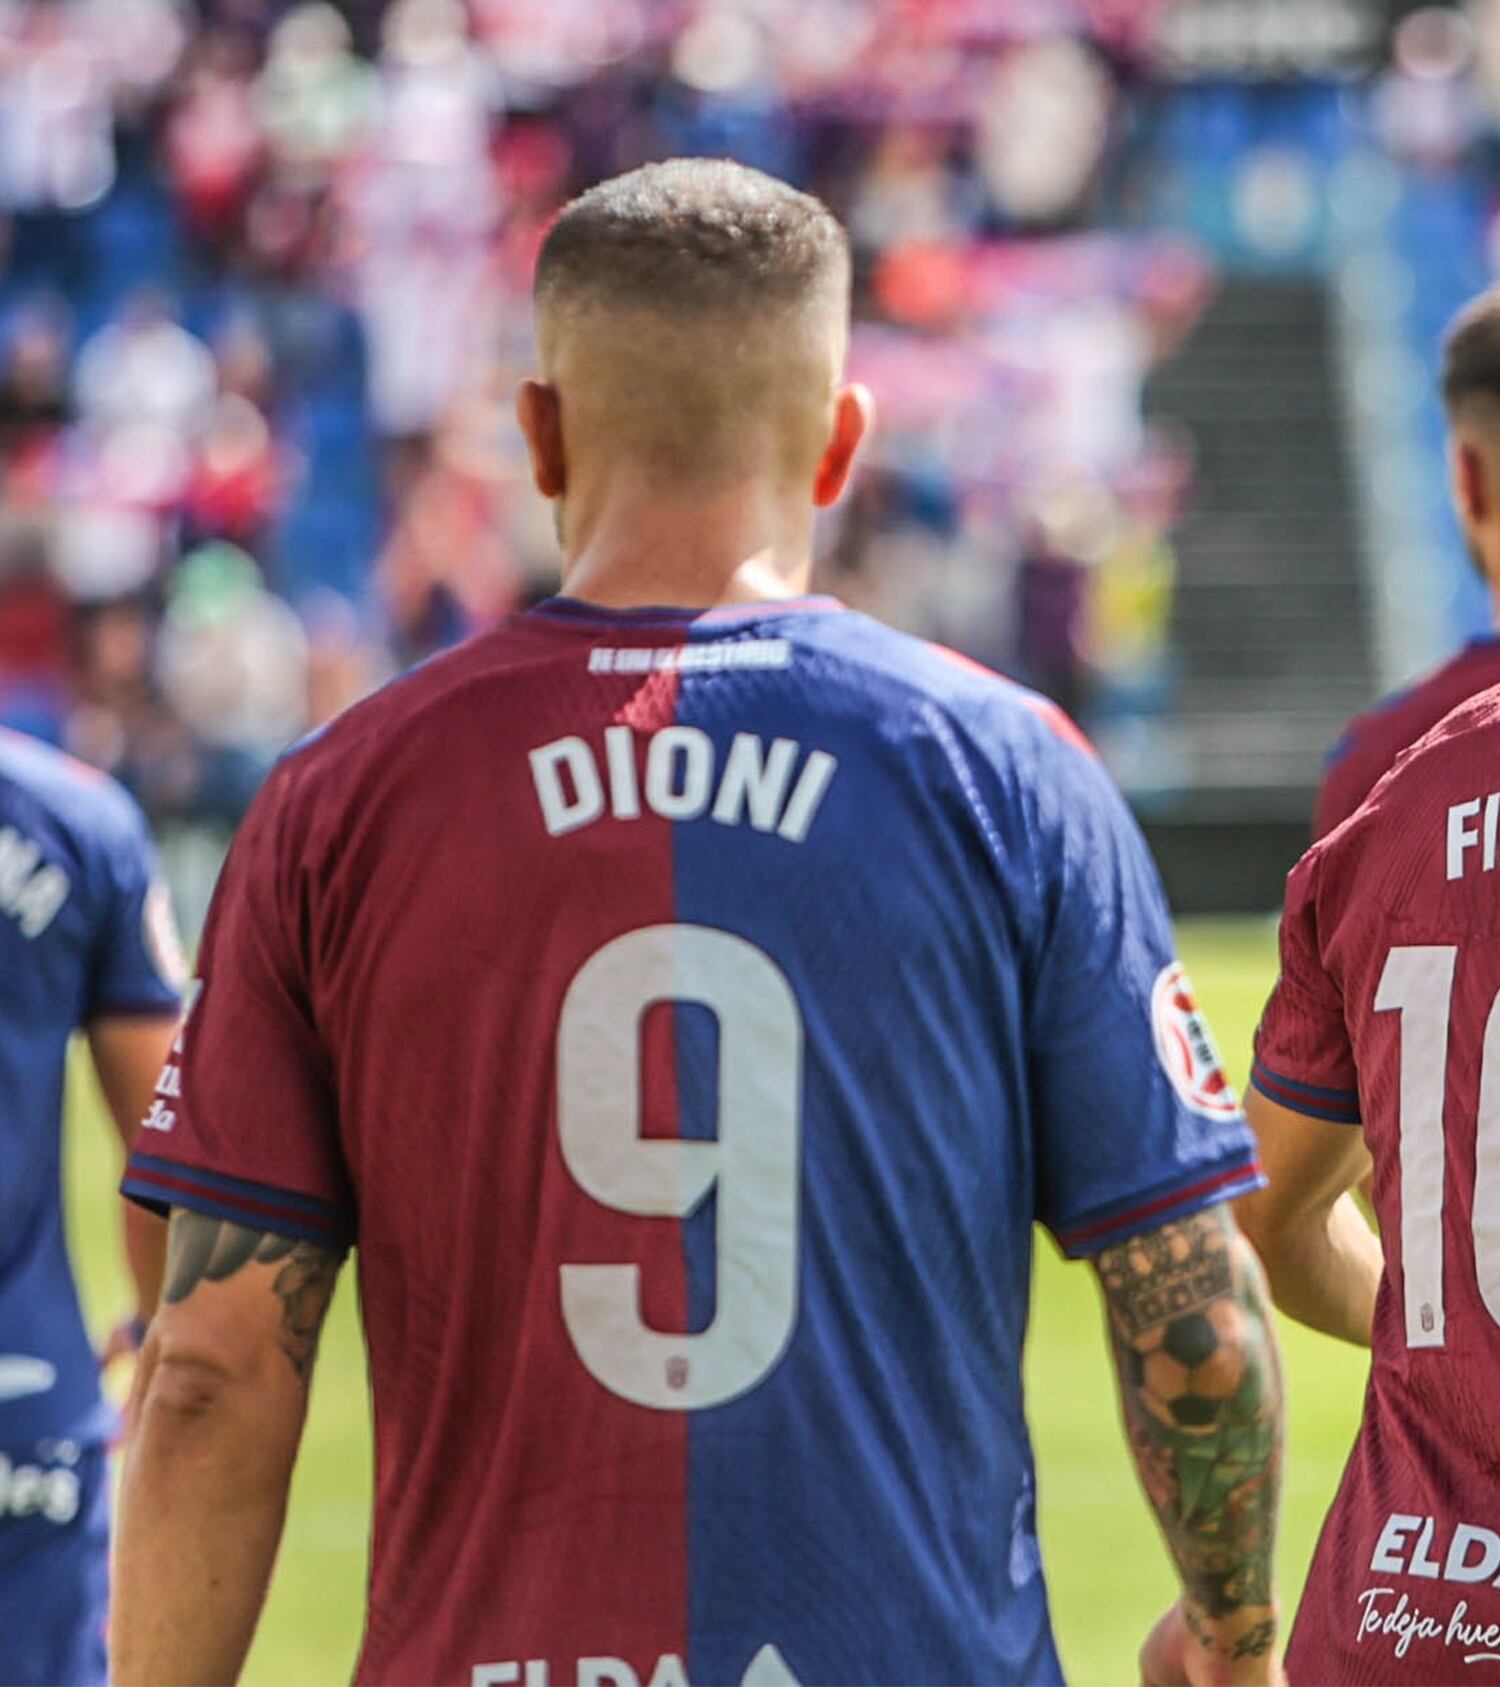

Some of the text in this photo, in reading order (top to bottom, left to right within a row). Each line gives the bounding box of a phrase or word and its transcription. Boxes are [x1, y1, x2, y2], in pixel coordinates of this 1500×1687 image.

[528, 725, 838, 844] DIONI
[556, 923, 805, 1413] 9
[1358, 1587, 1394, 1643] Te
[1382, 1593, 1442, 1659] deja
